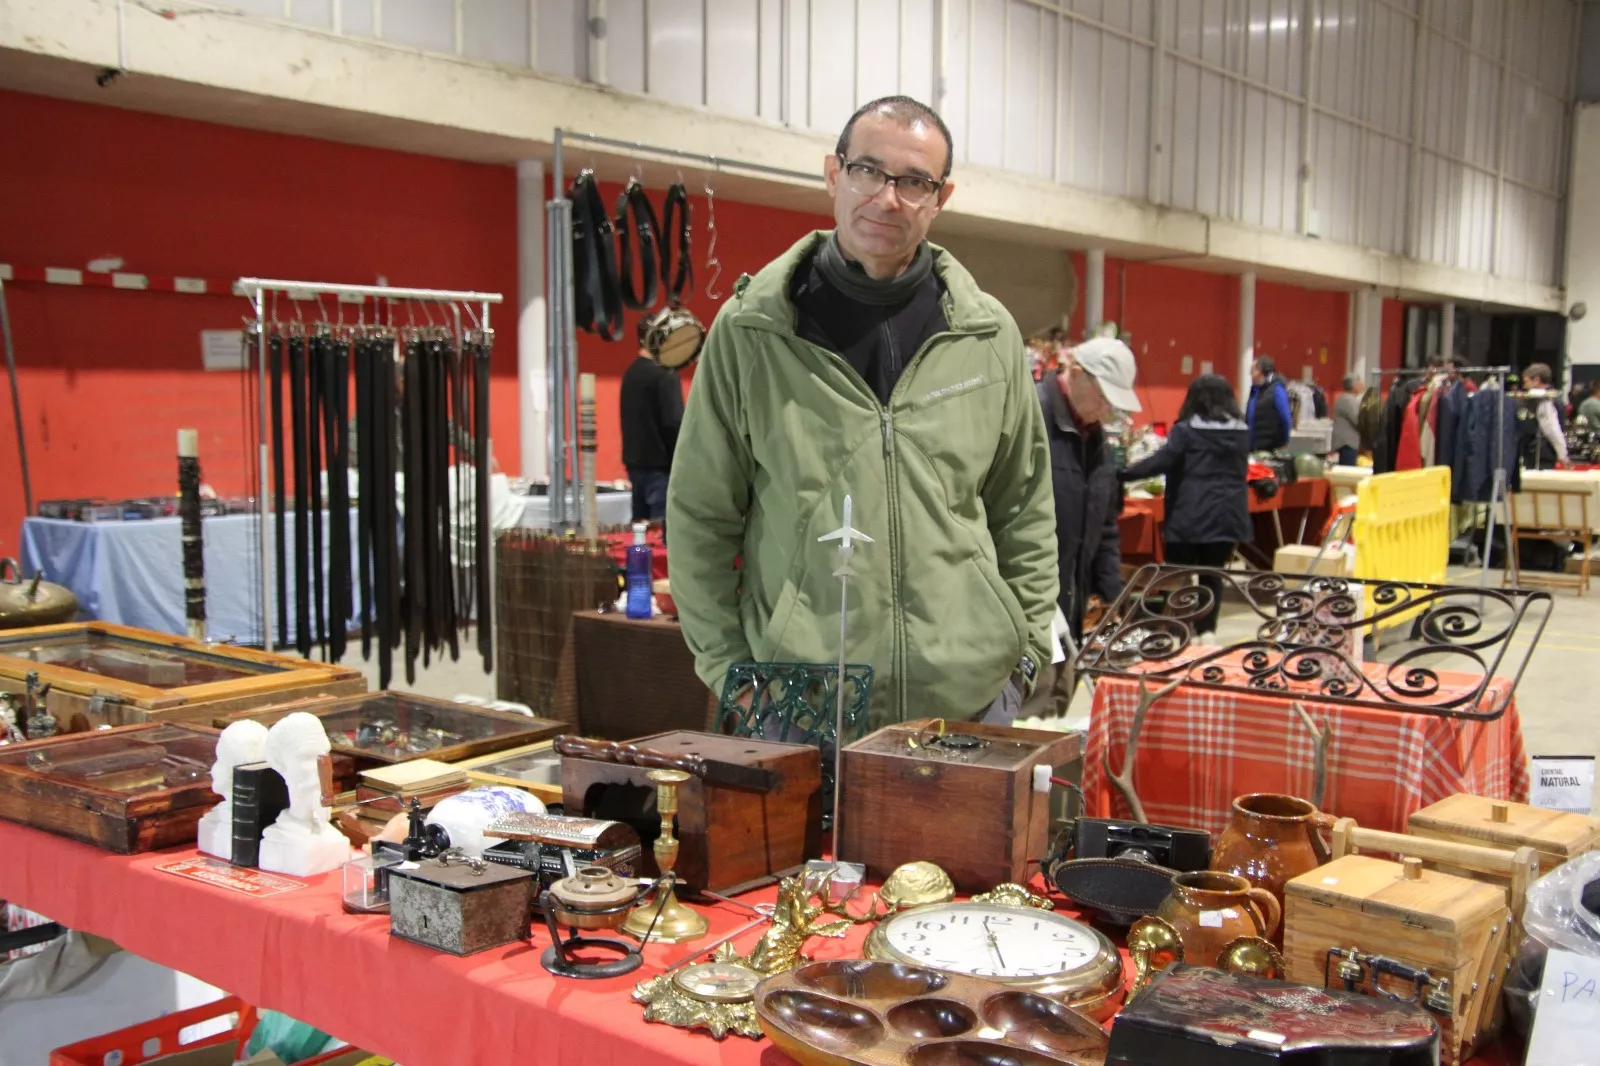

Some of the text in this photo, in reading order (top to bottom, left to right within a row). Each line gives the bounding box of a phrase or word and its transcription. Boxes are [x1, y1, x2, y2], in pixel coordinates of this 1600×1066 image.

[1541, 776, 1581, 787] NATURAL
[950, 915, 969, 924] 11
[984, 915, 1013, 925] 12
[916, 921, 947, 931] 10
[1033, 922, 1039, 930] 1
[901, 932, 927, 941] 9
[1052, 932, 1075, 942] 2
[906, 946, 931, 956] 8
[1063, 947, 1087, 957] 3
[1562, 971, 1600, 1002] PA
